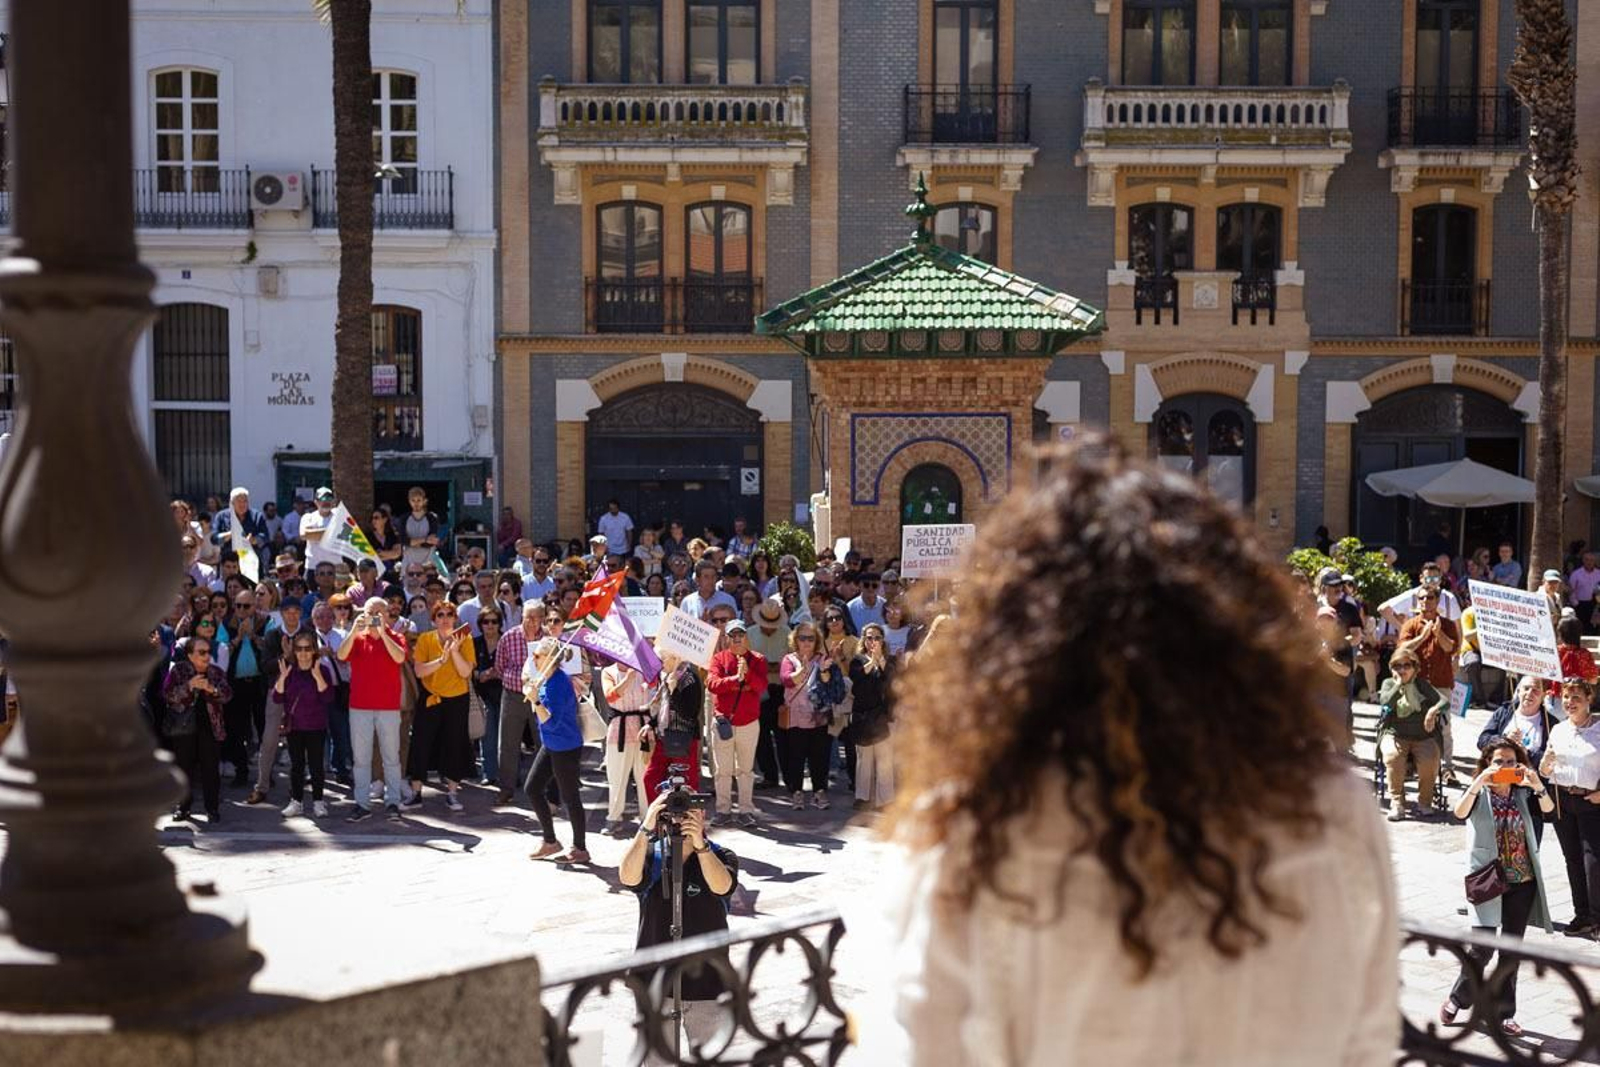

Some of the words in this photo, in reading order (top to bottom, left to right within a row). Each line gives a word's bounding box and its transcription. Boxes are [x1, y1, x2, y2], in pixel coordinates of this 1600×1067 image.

[272, 372, 310, 382] PLAZA
[284, 380, 297, 389] DE
[280, 388, 302, 397] LAS
[268, 396, 314, 405] MONJAS
[914, 527, 964, 537] SANIDAD
[918, 548, 960, 556] CALIDAD
[674, 624, 704, 644] NUESTROS
